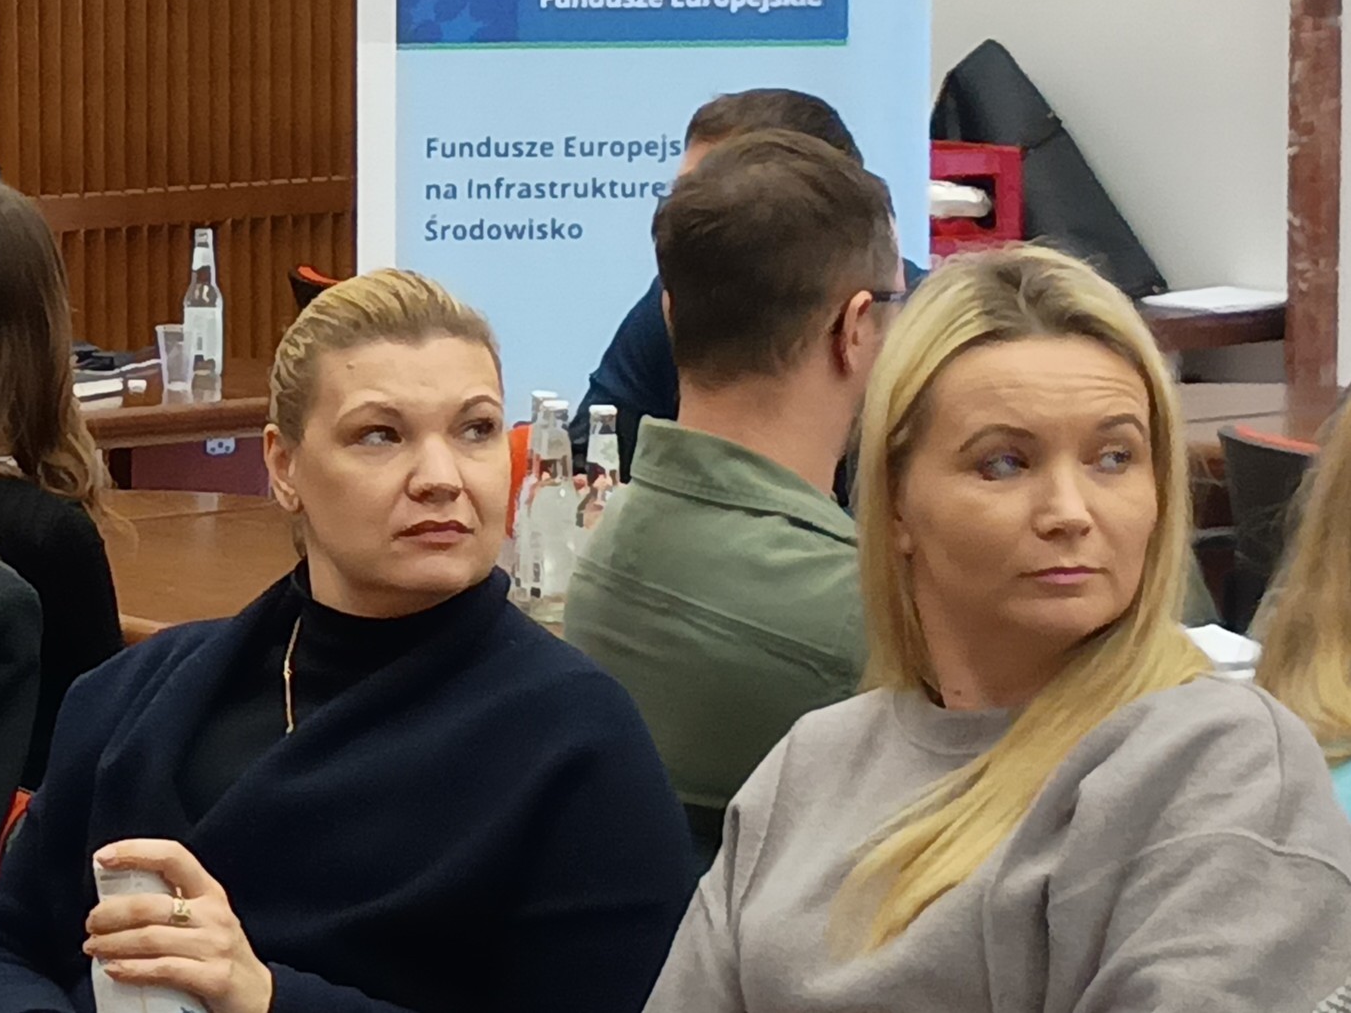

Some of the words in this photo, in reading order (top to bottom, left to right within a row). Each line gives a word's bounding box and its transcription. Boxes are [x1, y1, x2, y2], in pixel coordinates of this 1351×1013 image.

[427, 137, 553, 158] Fundusze
[565, 135, 681, 162] Europejs
[426, 184, 456, 199] na
[425, 215, 582, 241] Środowisko
